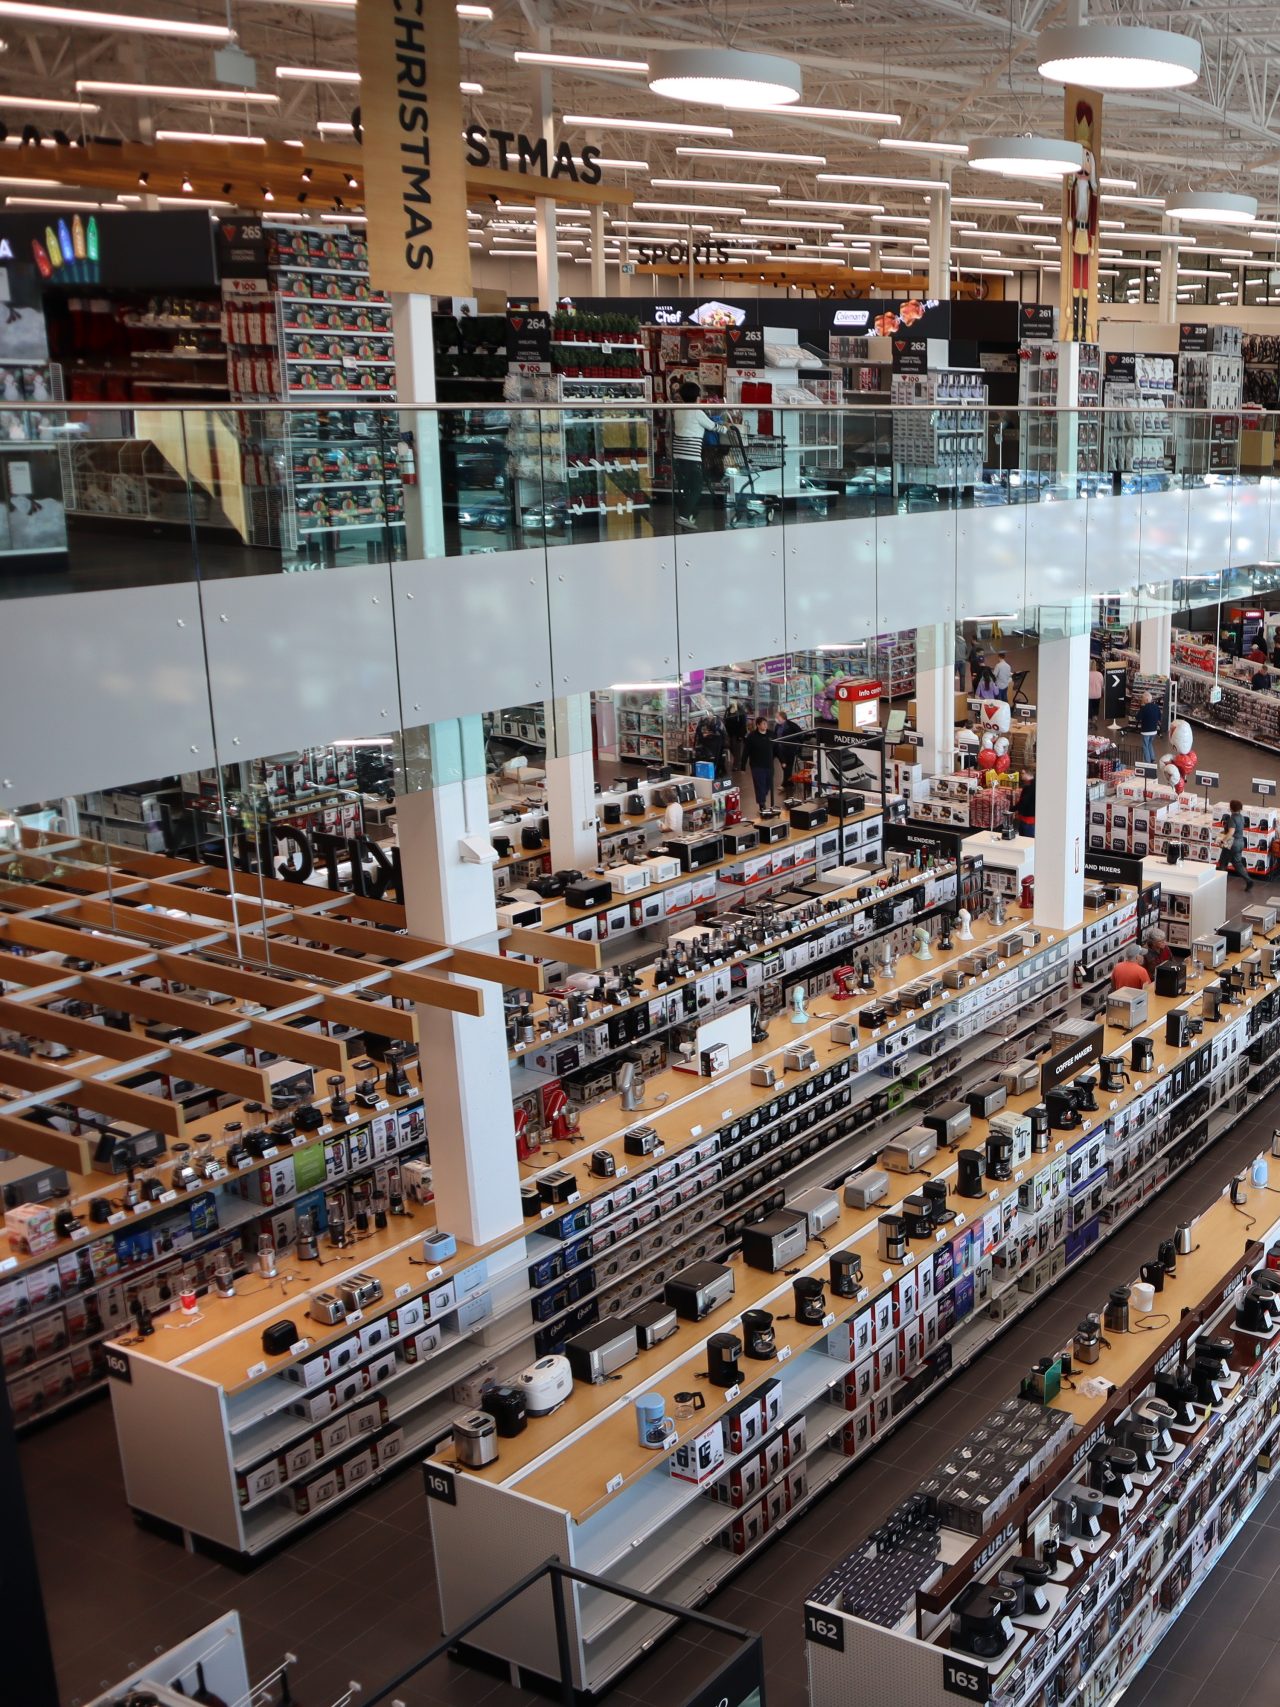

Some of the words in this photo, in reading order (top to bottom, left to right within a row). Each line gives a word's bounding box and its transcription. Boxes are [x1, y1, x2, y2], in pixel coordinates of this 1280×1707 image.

[242, 225, 261, 240] 265
[636, 241, 730, 266] SPORTS
[655, 310, 681, 324] Chef
[836, 311, 867, 321] Coleman
[1039, 310, 1051, 318] 261
[527, 319, 546, 330] 264
[1195, 327, 1207, 335] 259
[745, 331, 761, 341] 263
[910, 342, 926, 351] 262
[1121, 356, 1135, 365] 260
[859, 688, 870, 697] info
[982, 721, 999, 731] 100
[907, 835, 935, 845] BLENDERS
[1099, 865, 1121, 874] MIXERS
[1055, 1056, 1074, 1075] COFFEE
[1074, 1044, 1093, 1063] MAKERS
[1223, 1267, 1247, 1299] KEURIG
[1154, 1338, 1181, 1372] KEURIG
[106, 1355, 126, 1373] 160
[1073, 1421, 1106, 1466] KEURIG
[428, 1475, 448, 1494] 161
[973, 1522, 1014, 1573] KEURIG
[809, 1617, 837, 1639] 162
[948, 1668, 978, 1690] 163
